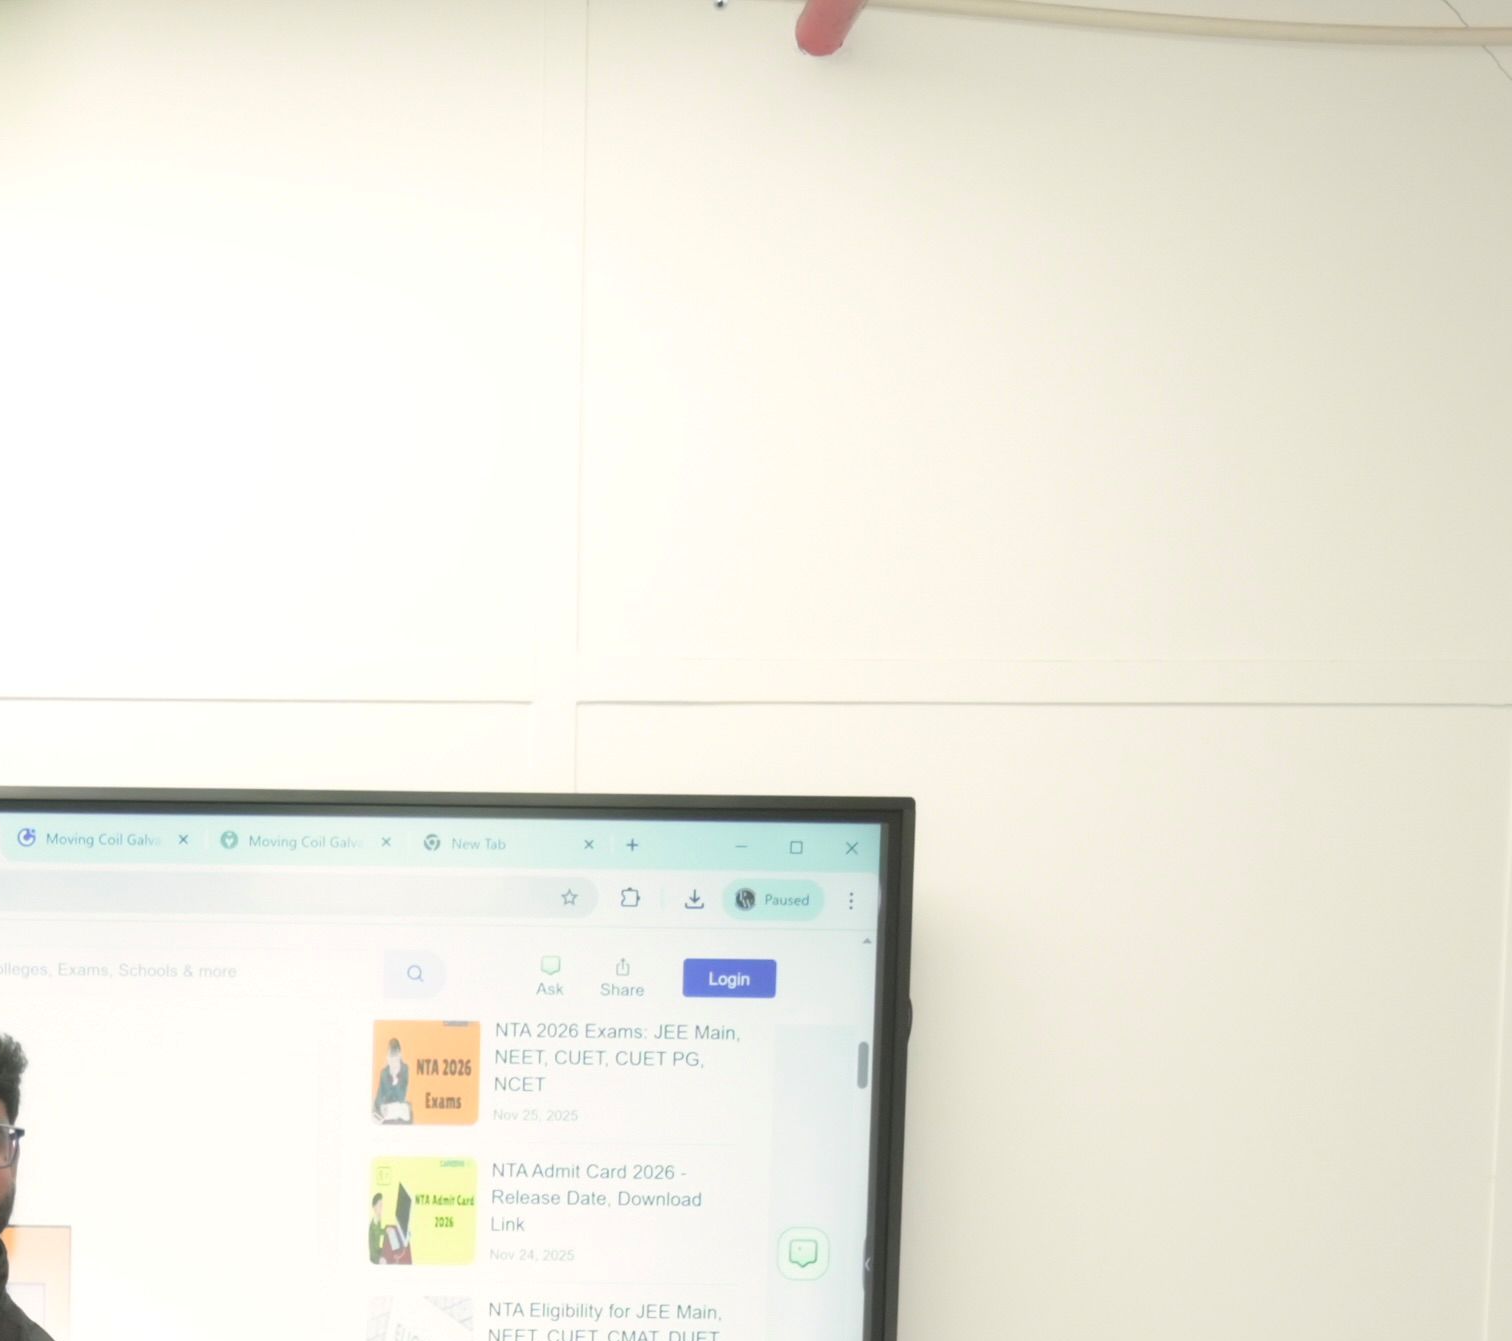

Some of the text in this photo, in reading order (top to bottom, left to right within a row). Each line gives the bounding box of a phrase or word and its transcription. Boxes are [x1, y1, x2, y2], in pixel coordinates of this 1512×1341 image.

[451, 837, 506, 850] New Tab
[764, 893, 810, 908] Paused
[118, 963, 177, 979] Schools
[182, 965, 194, 979] &
[199, 967, 237, 980] more
[708, 971, 751, 989] Login
[536, 982, 564, 997] Ask
[600, 982, 645, 997] Share
[495, 1022, 741, 1043] NTA 2026 Exams: JEE Main,
[416, 1058, 472, 1077] NTA 2026
[494, 1049, 705, 1069] NEET, CUET, CUET PG,
[494, 1076, 546, 1093] NCET
[424, 1092, 462, 1111] Exams
[493, 1109, 519, 1122] Nov
[546, 1109, 579, 1122] 2025
[491, 1162, 676, 1180] NTA Admit Card 2026
[491, 1189, 703, 1208] Release Date, Download
[490, 1216, 526, 1233] Link
[488, 1302, 722, 1323] NTA Eligibility for JEE Main,
